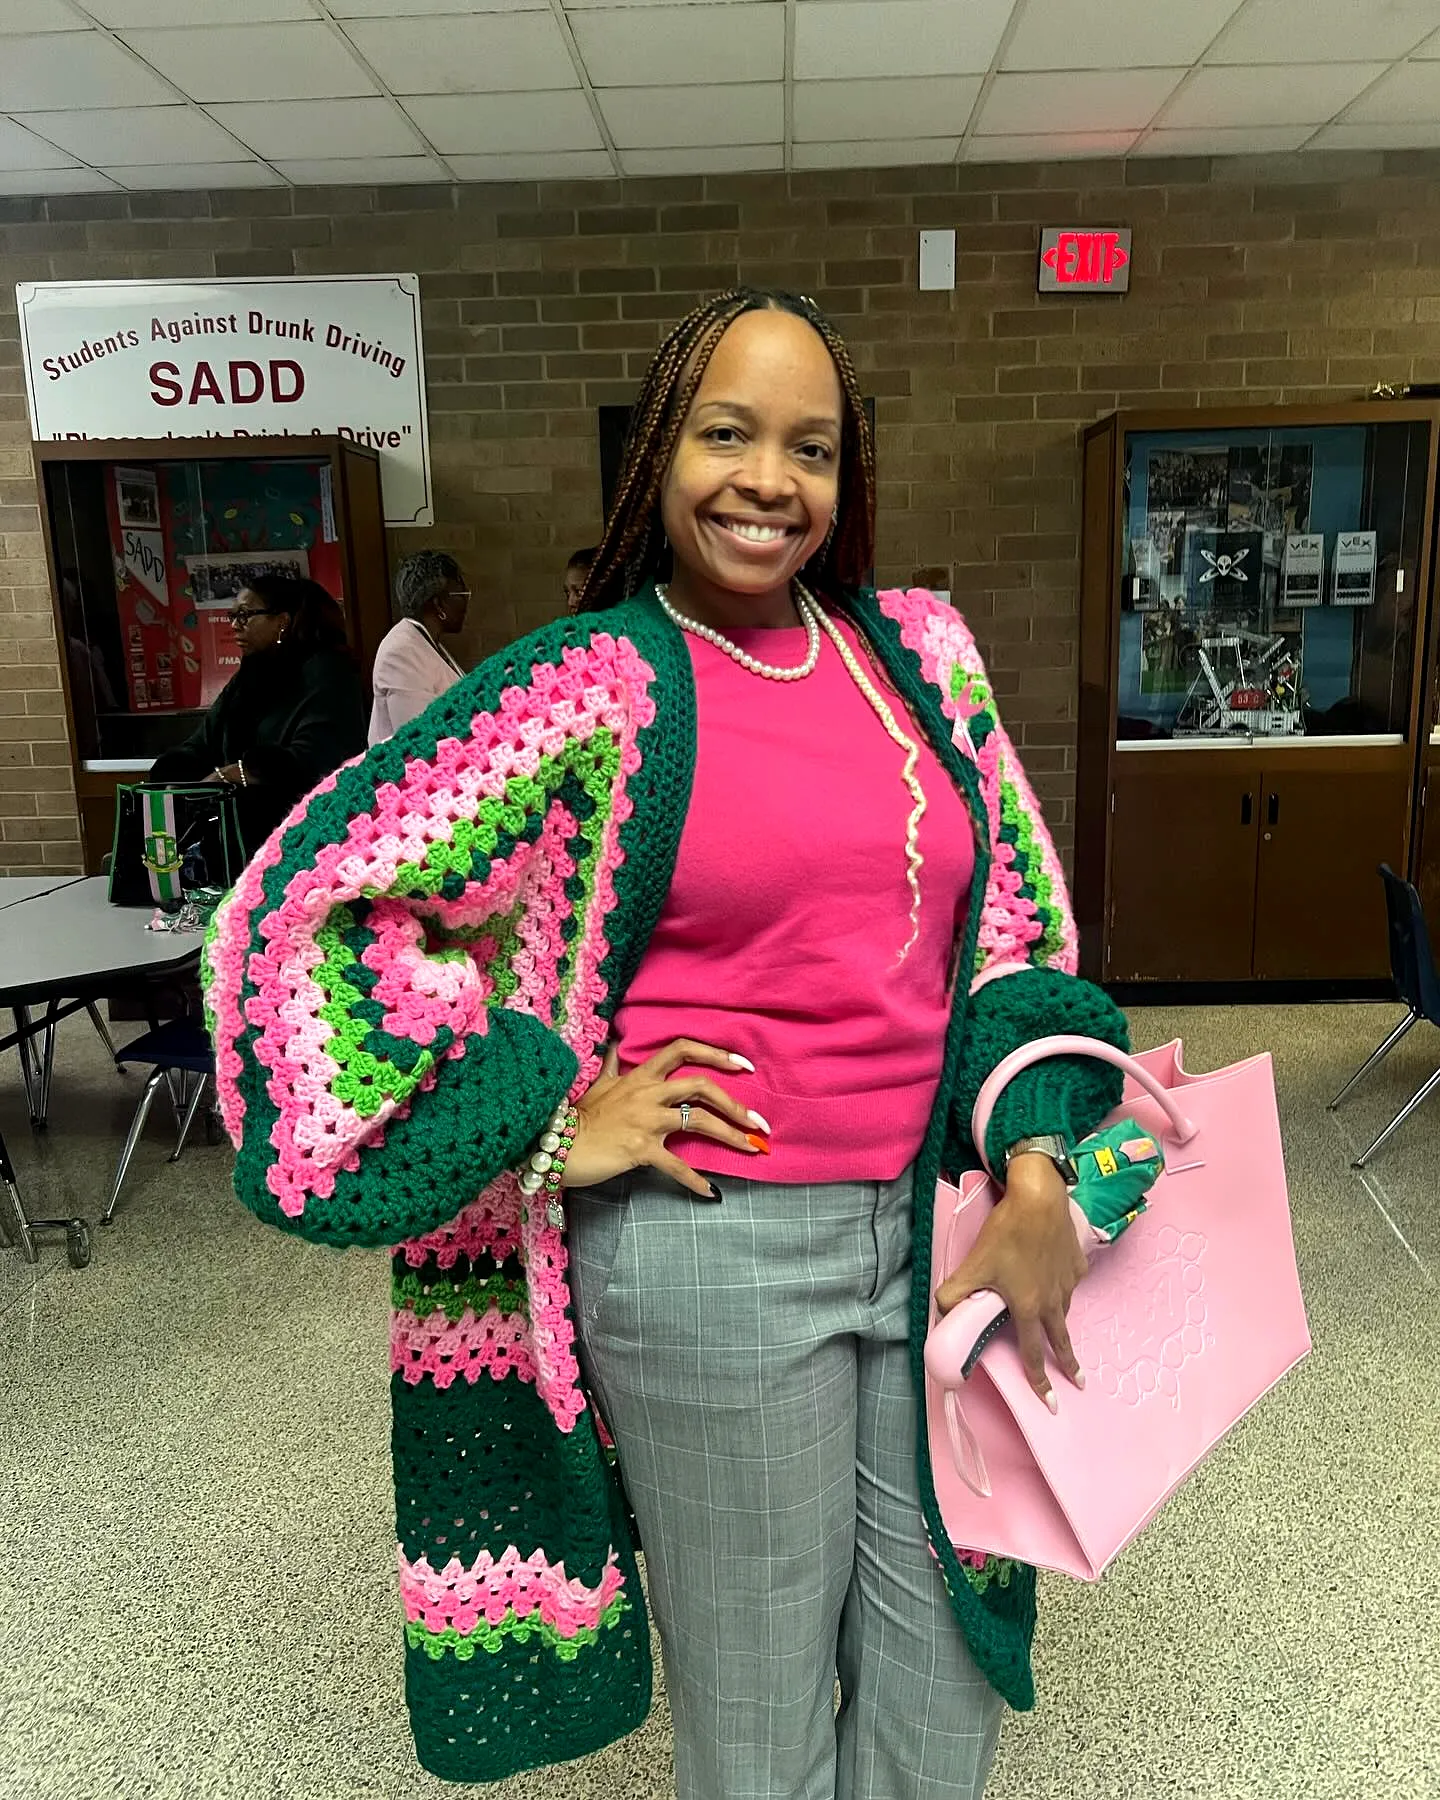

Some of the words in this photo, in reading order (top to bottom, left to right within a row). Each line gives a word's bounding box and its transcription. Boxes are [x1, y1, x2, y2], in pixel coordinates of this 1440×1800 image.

[1057, 232, 1120, 283] EXIT
[43, 330, 139, 381] Students
[151, 312, 238, 343] Against
[248, 311, 315, 342] Drunk
[326, 324, 406, 378] Driving
[149, 359, 305, 407] SADD
[125, 531, 165, 583] SADD
[1290, 538, 1320, 551] VEX
[1341, 535, 1370, 549] VEX
[218, 655, 243, 665] #MA
